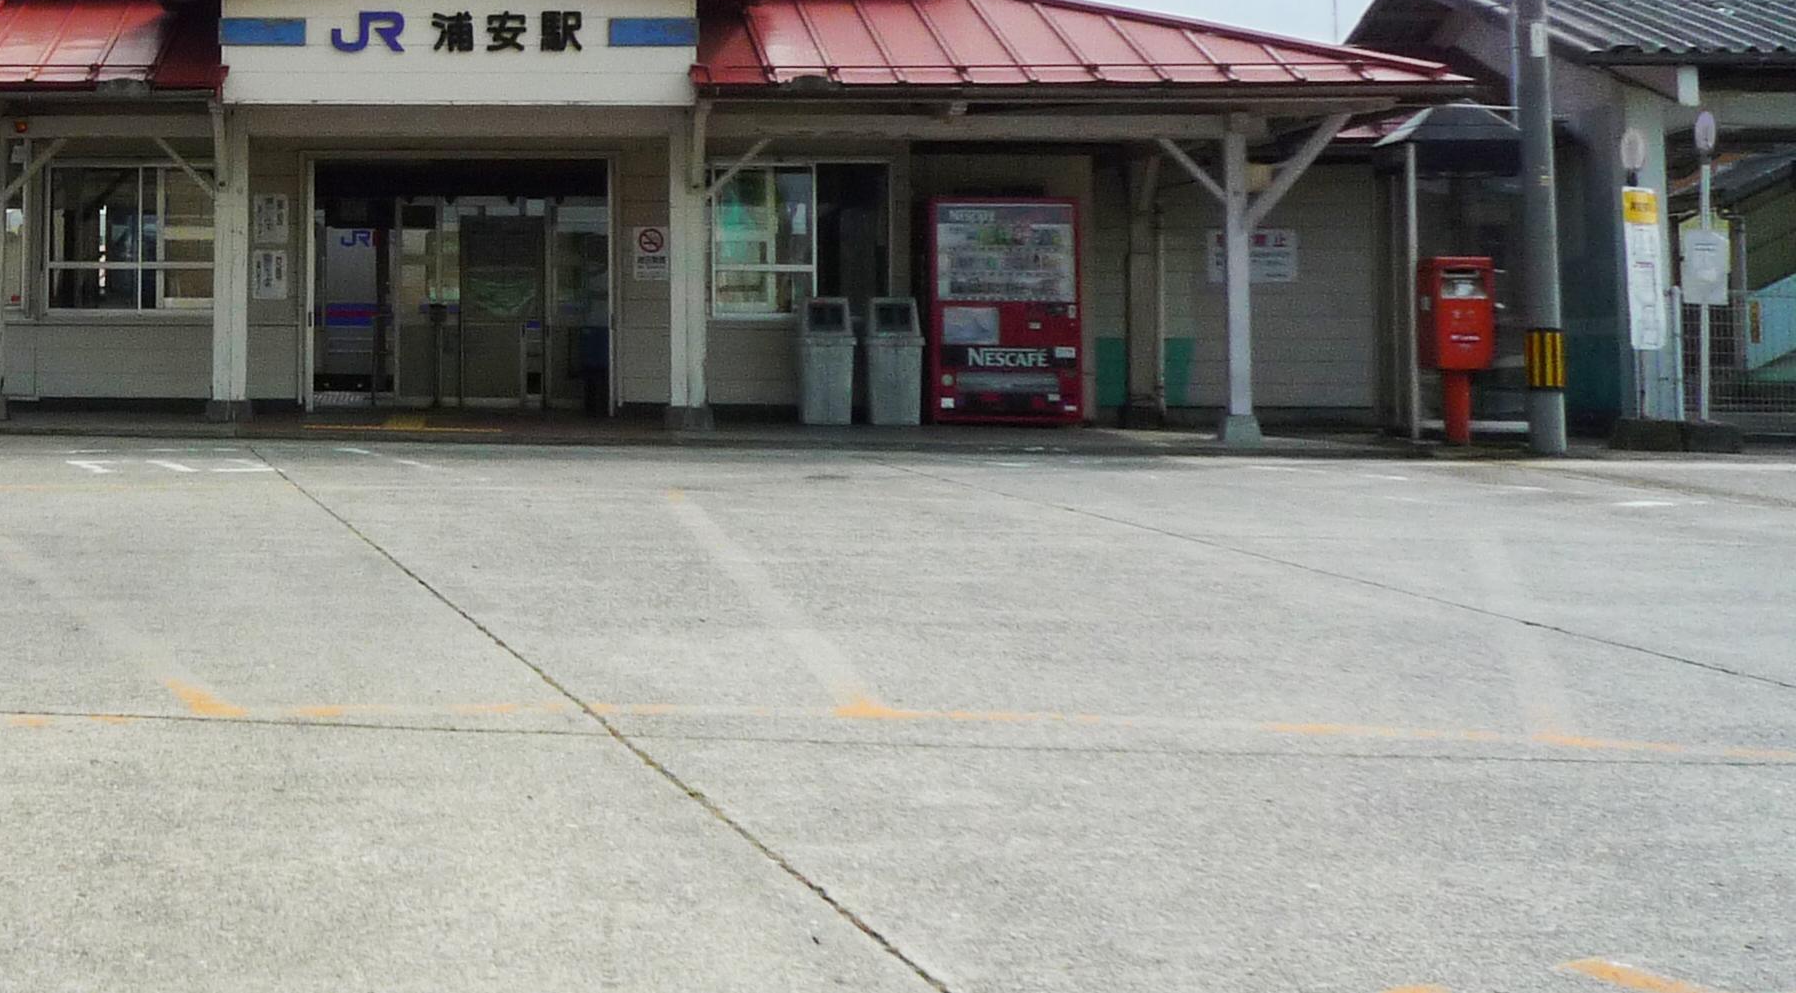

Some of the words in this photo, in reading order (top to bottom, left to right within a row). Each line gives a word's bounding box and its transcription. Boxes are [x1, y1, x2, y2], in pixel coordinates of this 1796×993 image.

[330, 10, 405, 53] JR
[430, 10, 584, 53] 浦安駅
[340, 229, 372, 248] JR
[967, 346, 1050, 367] NESCAFÉ
